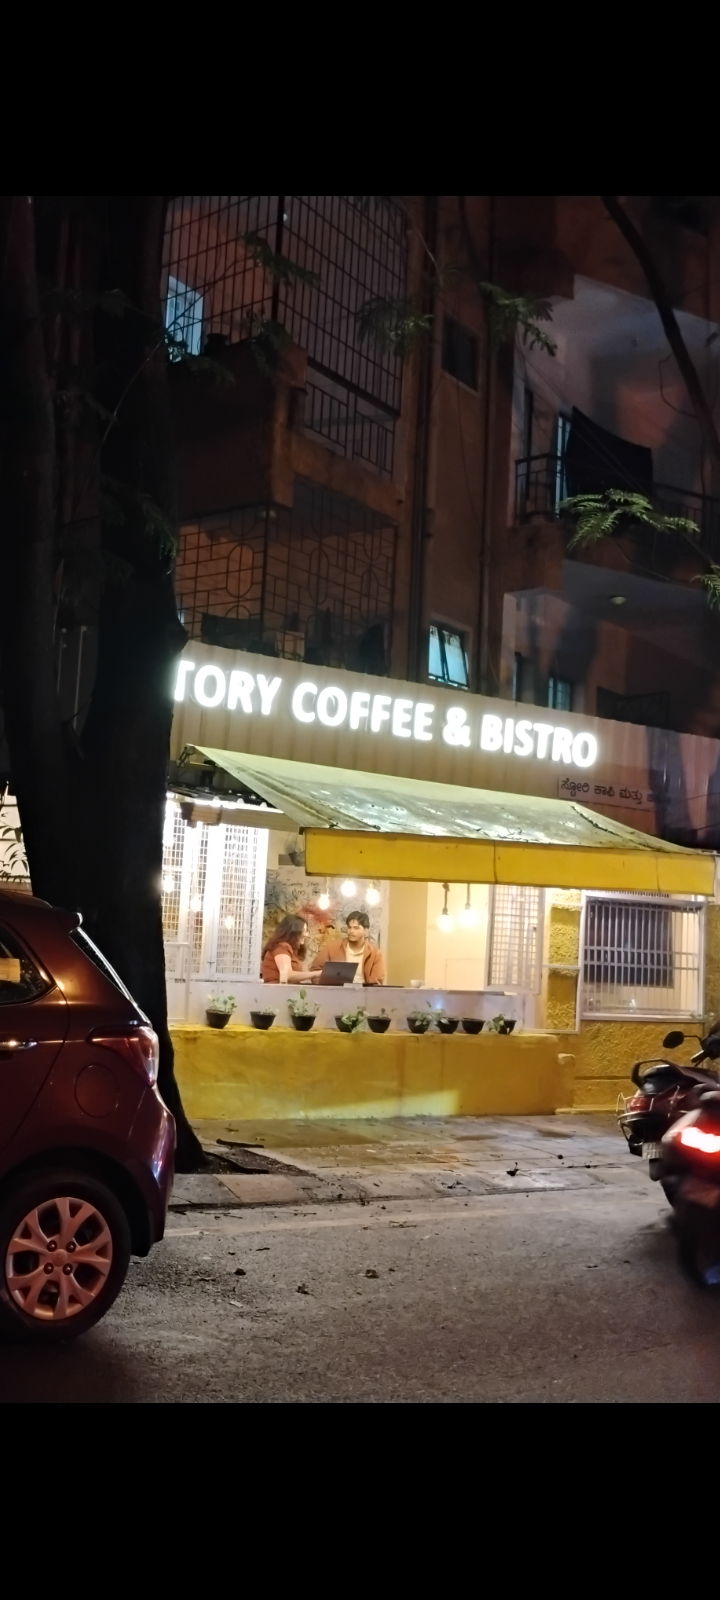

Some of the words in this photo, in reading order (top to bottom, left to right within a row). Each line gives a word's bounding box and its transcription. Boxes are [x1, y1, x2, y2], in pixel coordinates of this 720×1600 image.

[292, 682, 434, 741] COFFEE
[443, 707, 471, 747] &
[480, 714, 597, 768] BISTRO
[619, 787, 643, 804] ಮತ್ತು
